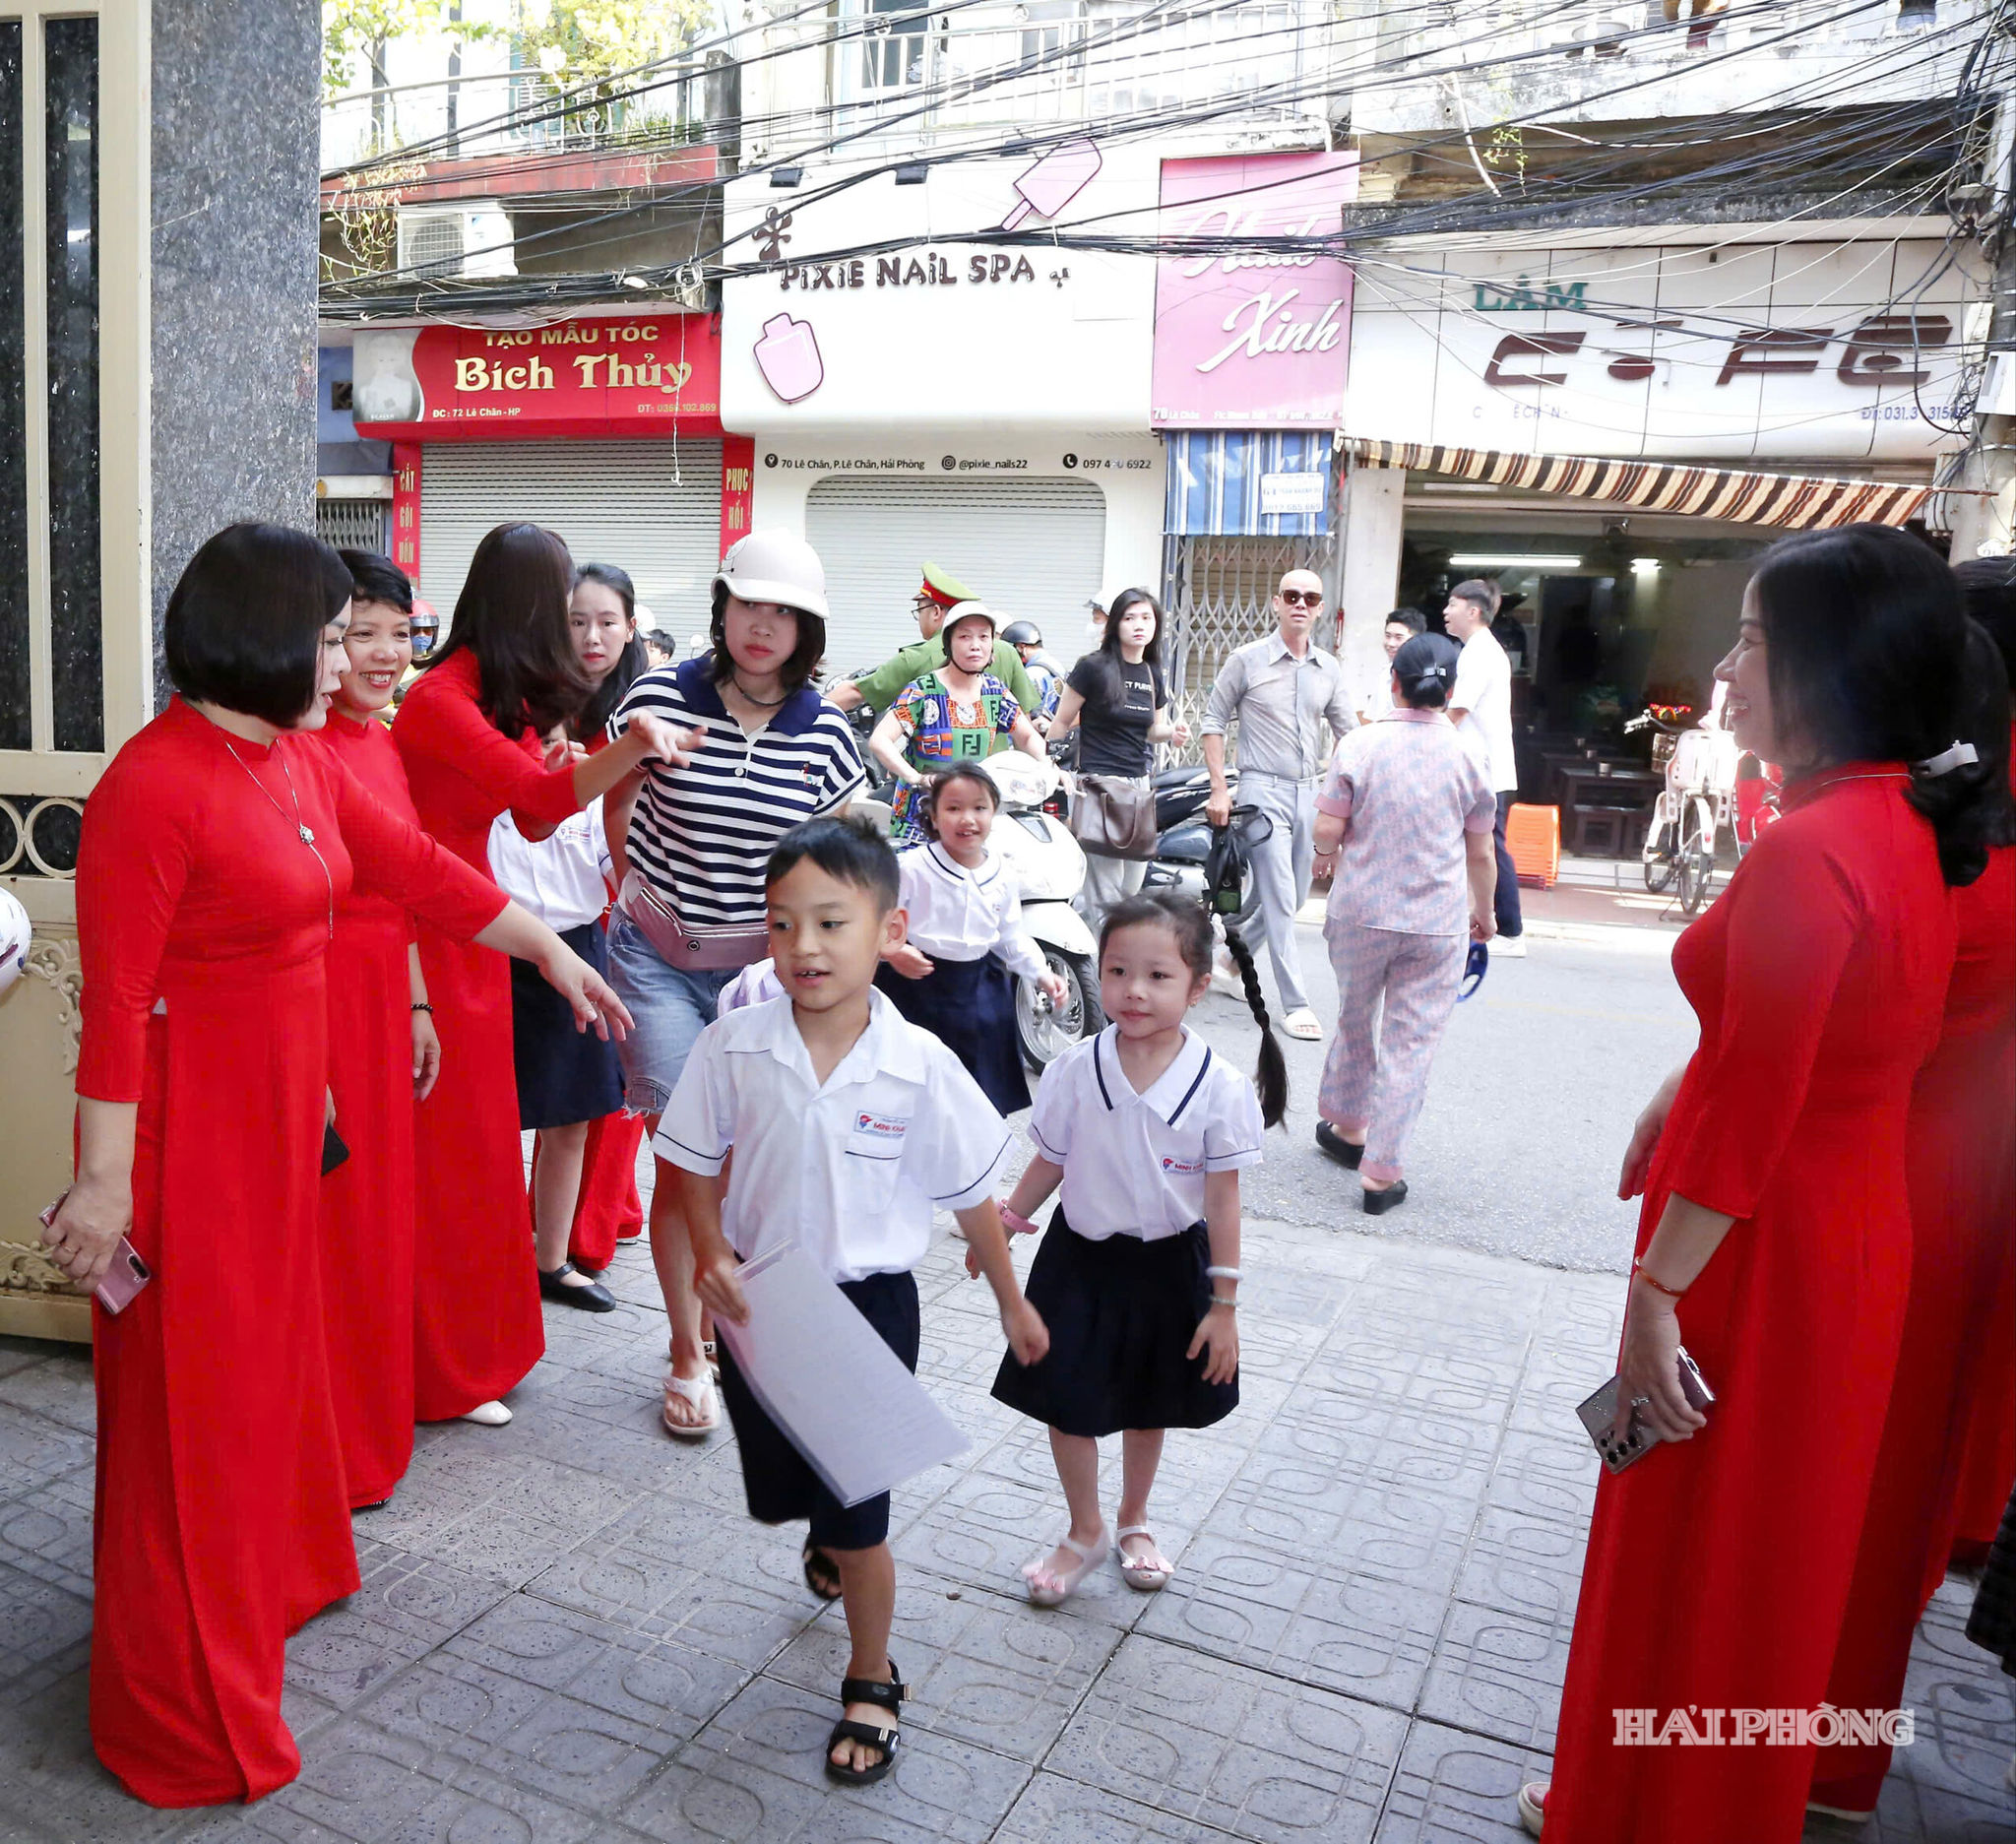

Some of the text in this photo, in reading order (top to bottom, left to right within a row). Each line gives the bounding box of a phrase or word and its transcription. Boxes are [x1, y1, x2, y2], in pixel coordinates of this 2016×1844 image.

[968, 253, 1036, 284] SPA
[1473, 274, 1590, 310] LÂM
[482, 321, 659, 350] TẠO MẪU TÓC
[1195, 288, 1346, 373] Xinh
[454, 352, 693, 395] Bích Thủy
[453, 408, 464, 417] 72
[466, 407, 477, 417] Lê
[781, 459, 792, 469] 70
[794, 458, 805, 469] Lê
[880, 458, 896, 469] Hải
[896, 459, 925, 471] Phòng
[958, 459, 1029, 471] @pixie_nails22
[1083, 459, 1102, 469] 097
[1126, 459, 1152, 470] 6922
[725, 468, 749, 496] PHỤC
